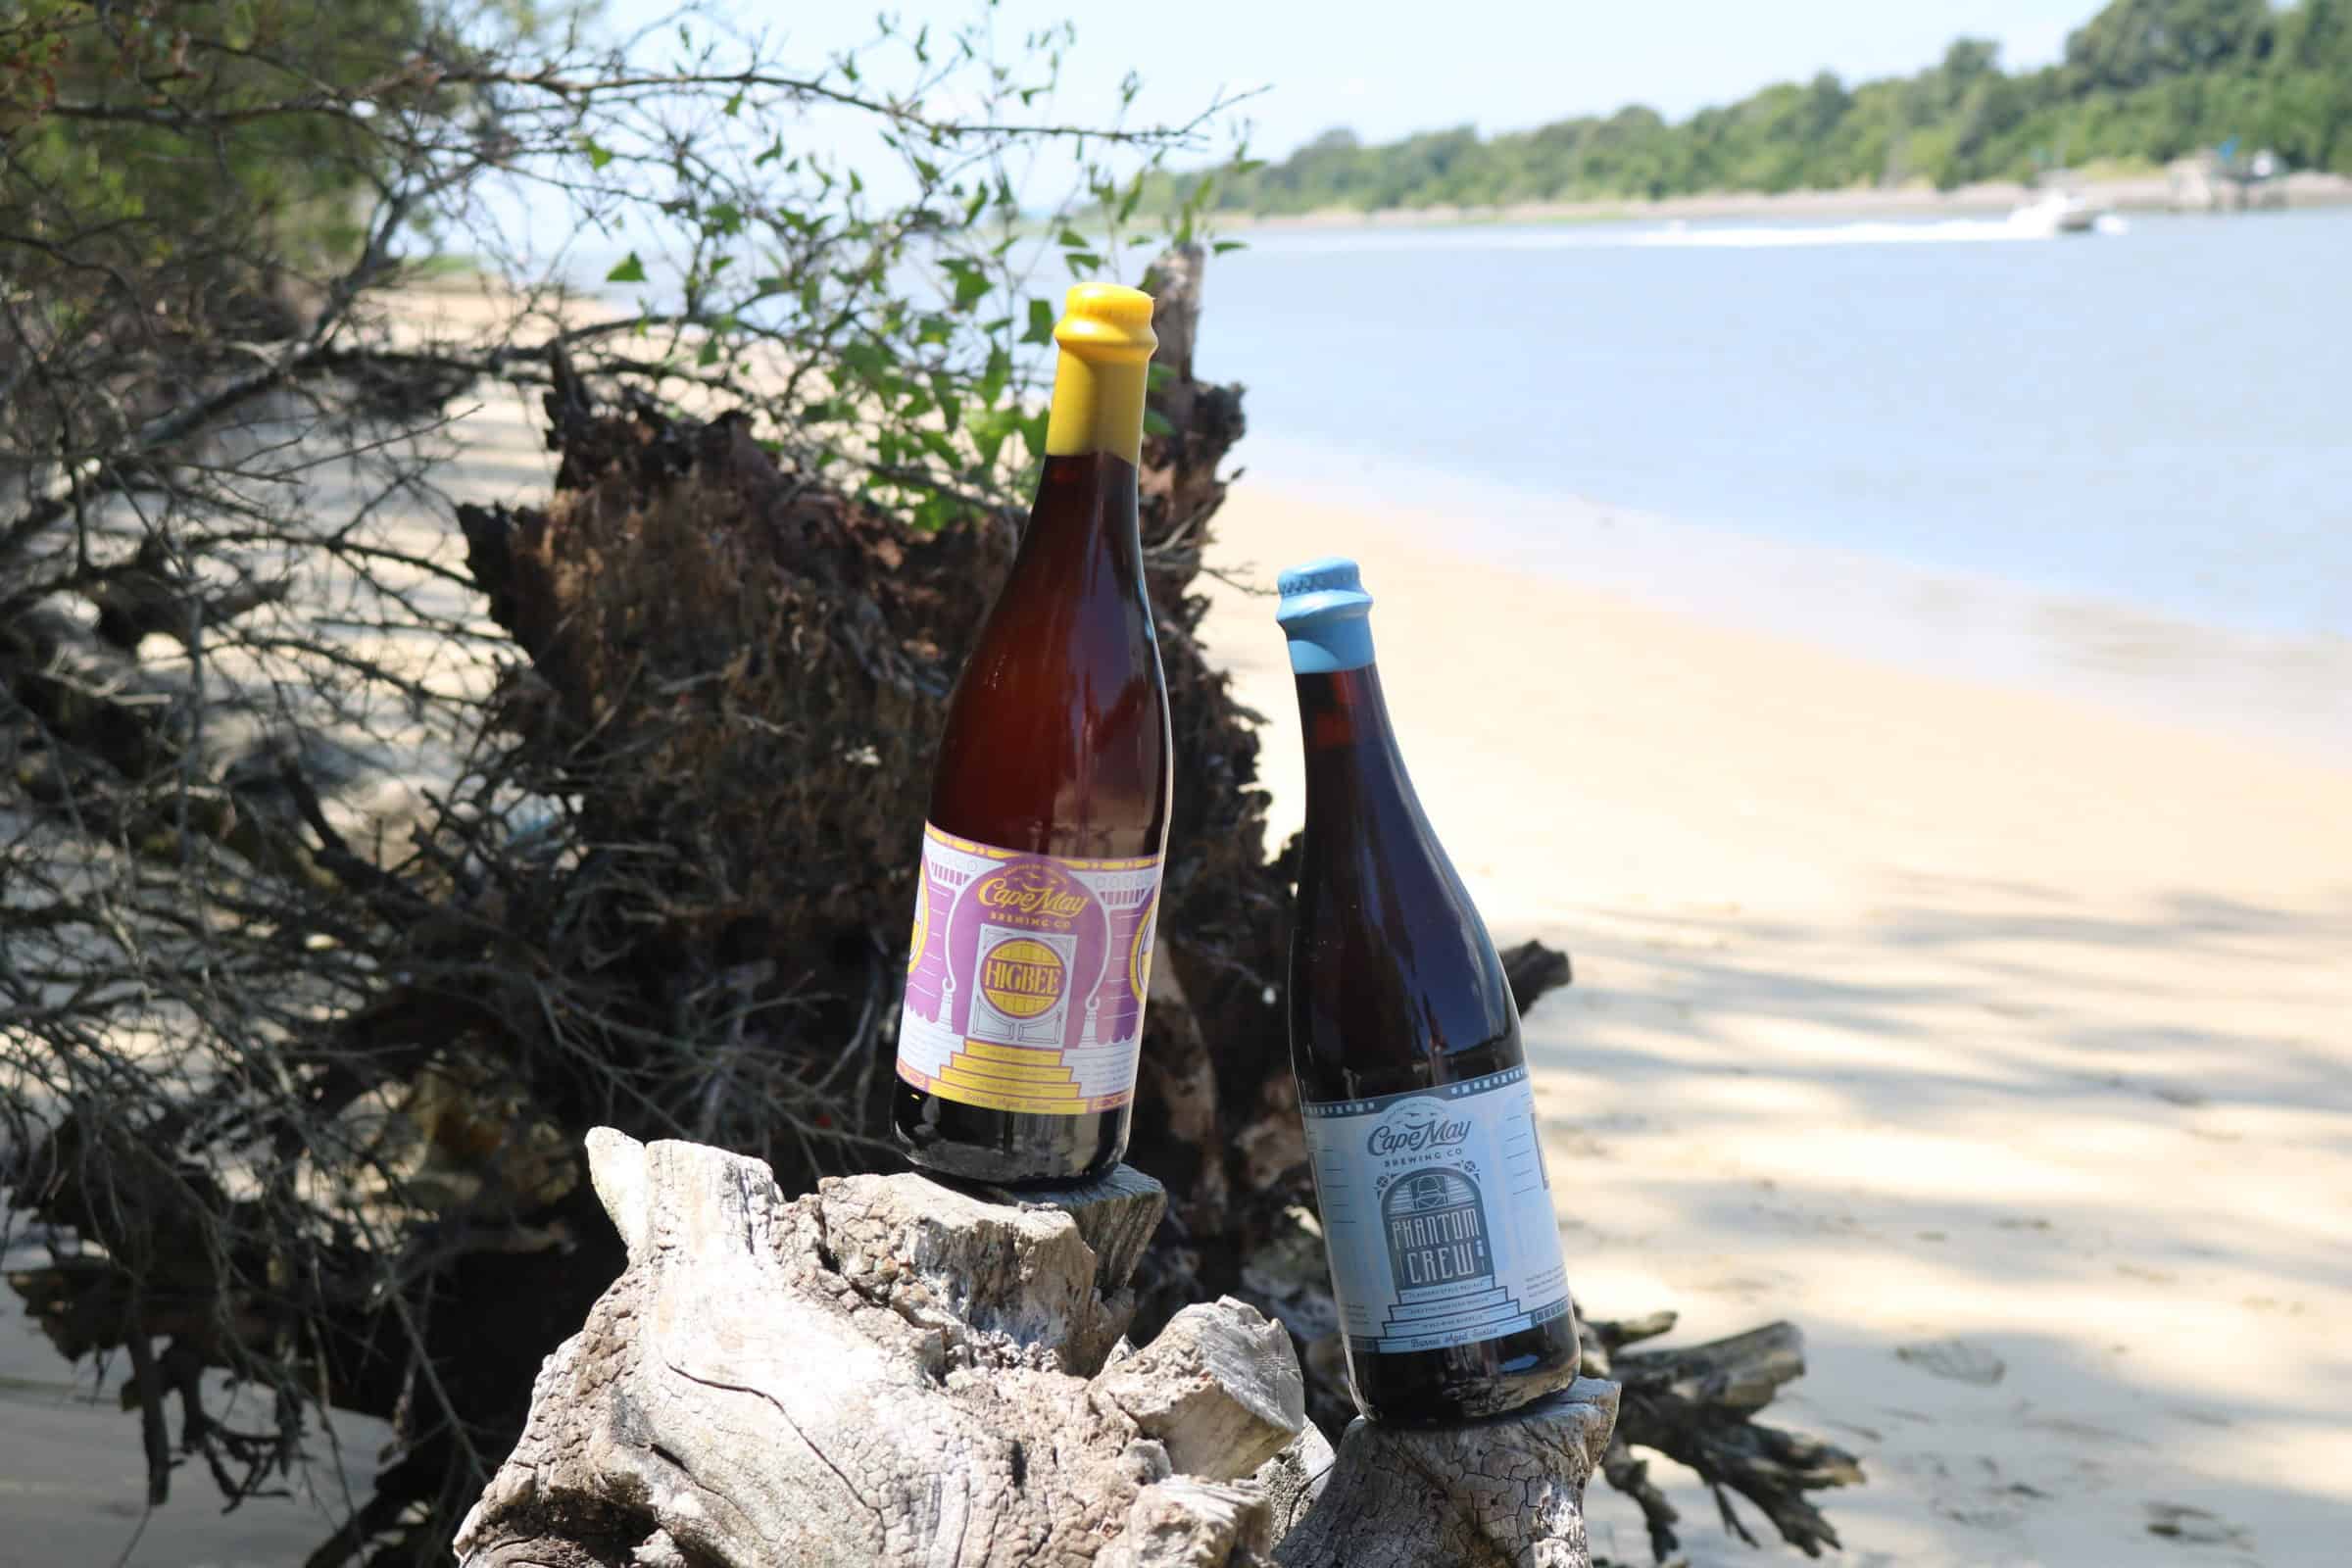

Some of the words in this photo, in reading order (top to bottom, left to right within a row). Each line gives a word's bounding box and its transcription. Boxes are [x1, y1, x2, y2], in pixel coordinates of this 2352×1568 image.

[977, 877, 1034, 909] Cape
[1021, 886, 1090, 918] May
[989, 910, 1051, 927] BREWING
[984, 959, 1062, 996] HIGBEE
[1367, 1124, 1422, 1157] Cape
[1410, 1118, 1473, 1152] May
[1384, 1152, 1443, 1168] BREWING
[1391, 1206, 1481, 1250] PHANTOM
[1405, 1243, 1475, 1285] CREW
